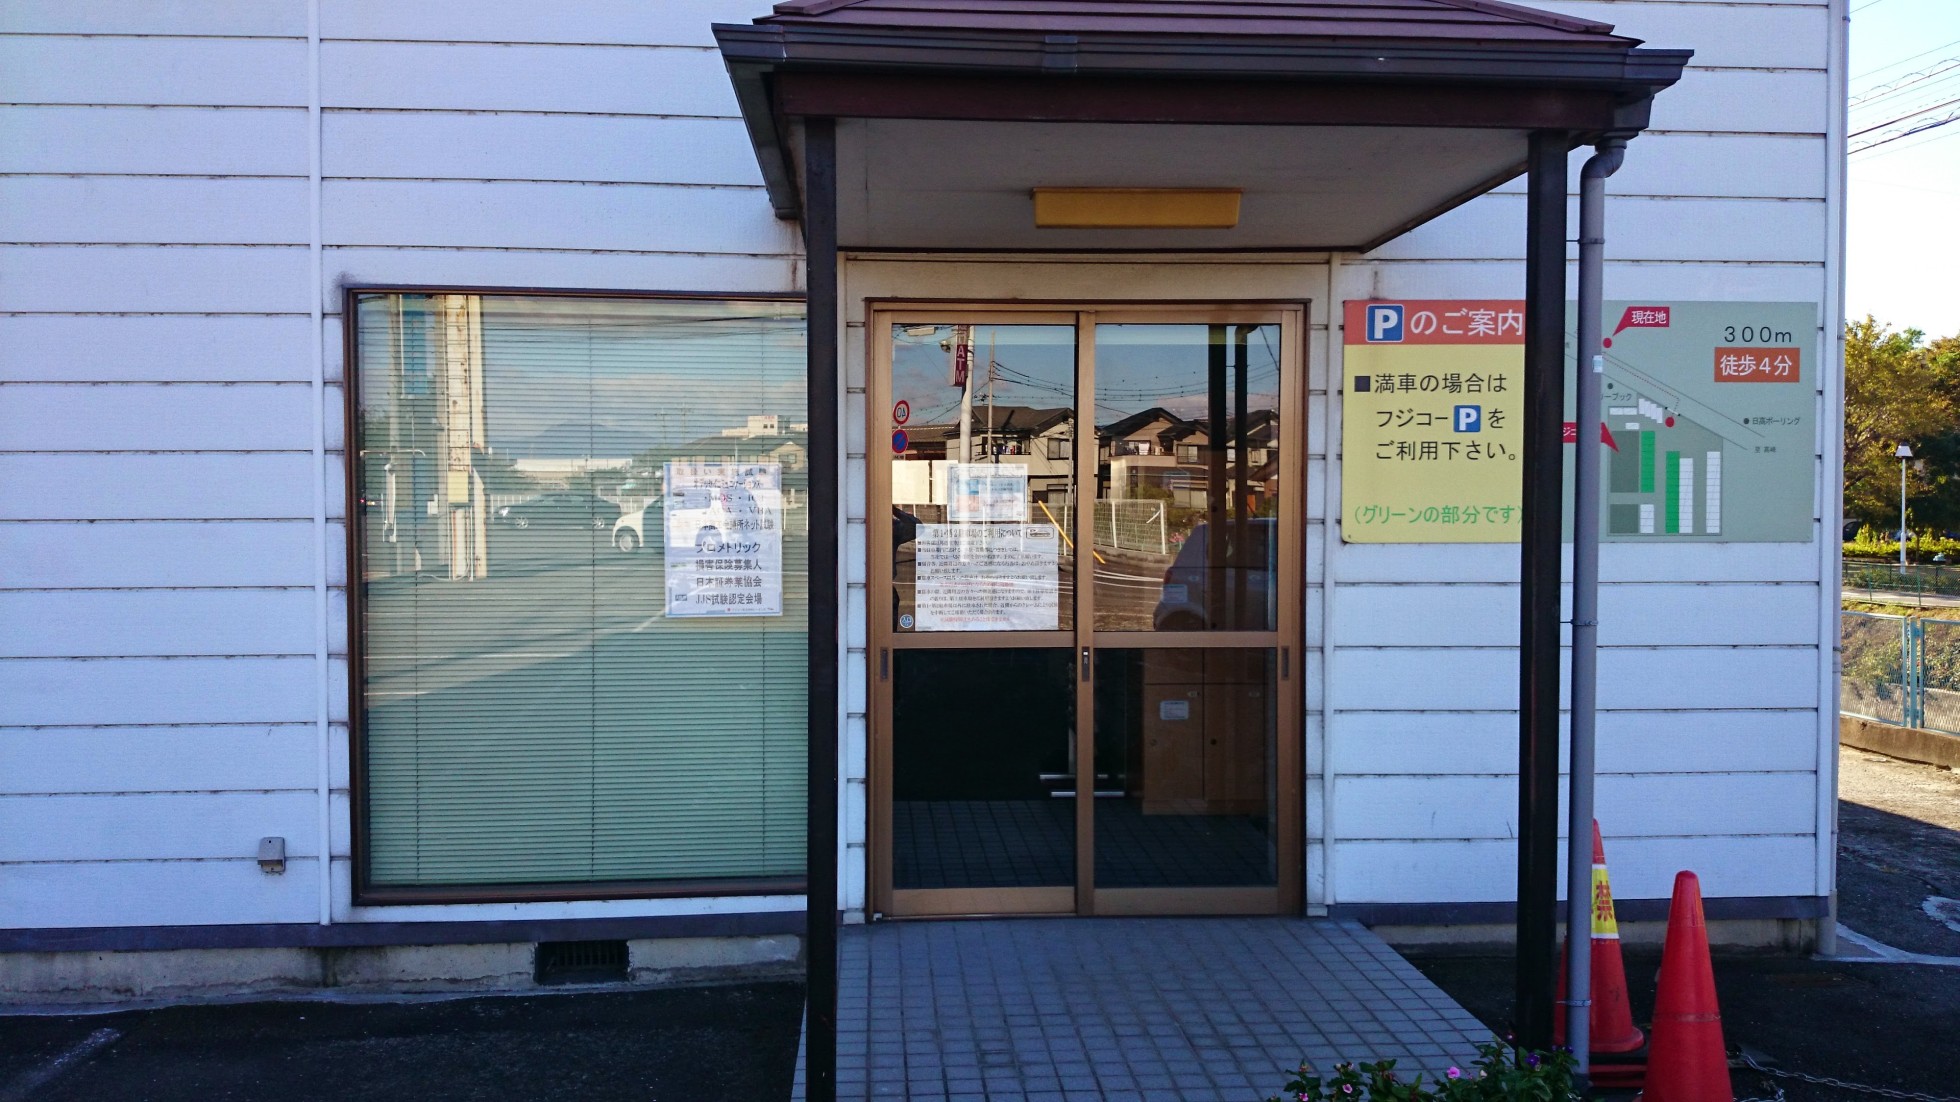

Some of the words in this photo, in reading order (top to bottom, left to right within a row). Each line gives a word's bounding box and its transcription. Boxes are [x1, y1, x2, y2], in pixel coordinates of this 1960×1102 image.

[1632, 310, 1667, 324] 現在地
[1724, 326, 1792, 343] 300m
[1720, 355, 1792, 376] 徒歩4分
[1374, 373, 1507, 394] 満車の場合は
[1376, 440, 1517, 461] ご利用下さい。
[695, 541, 761, 553] プロメトリック
[696, 559, 762, 571] 損害保険募集人
